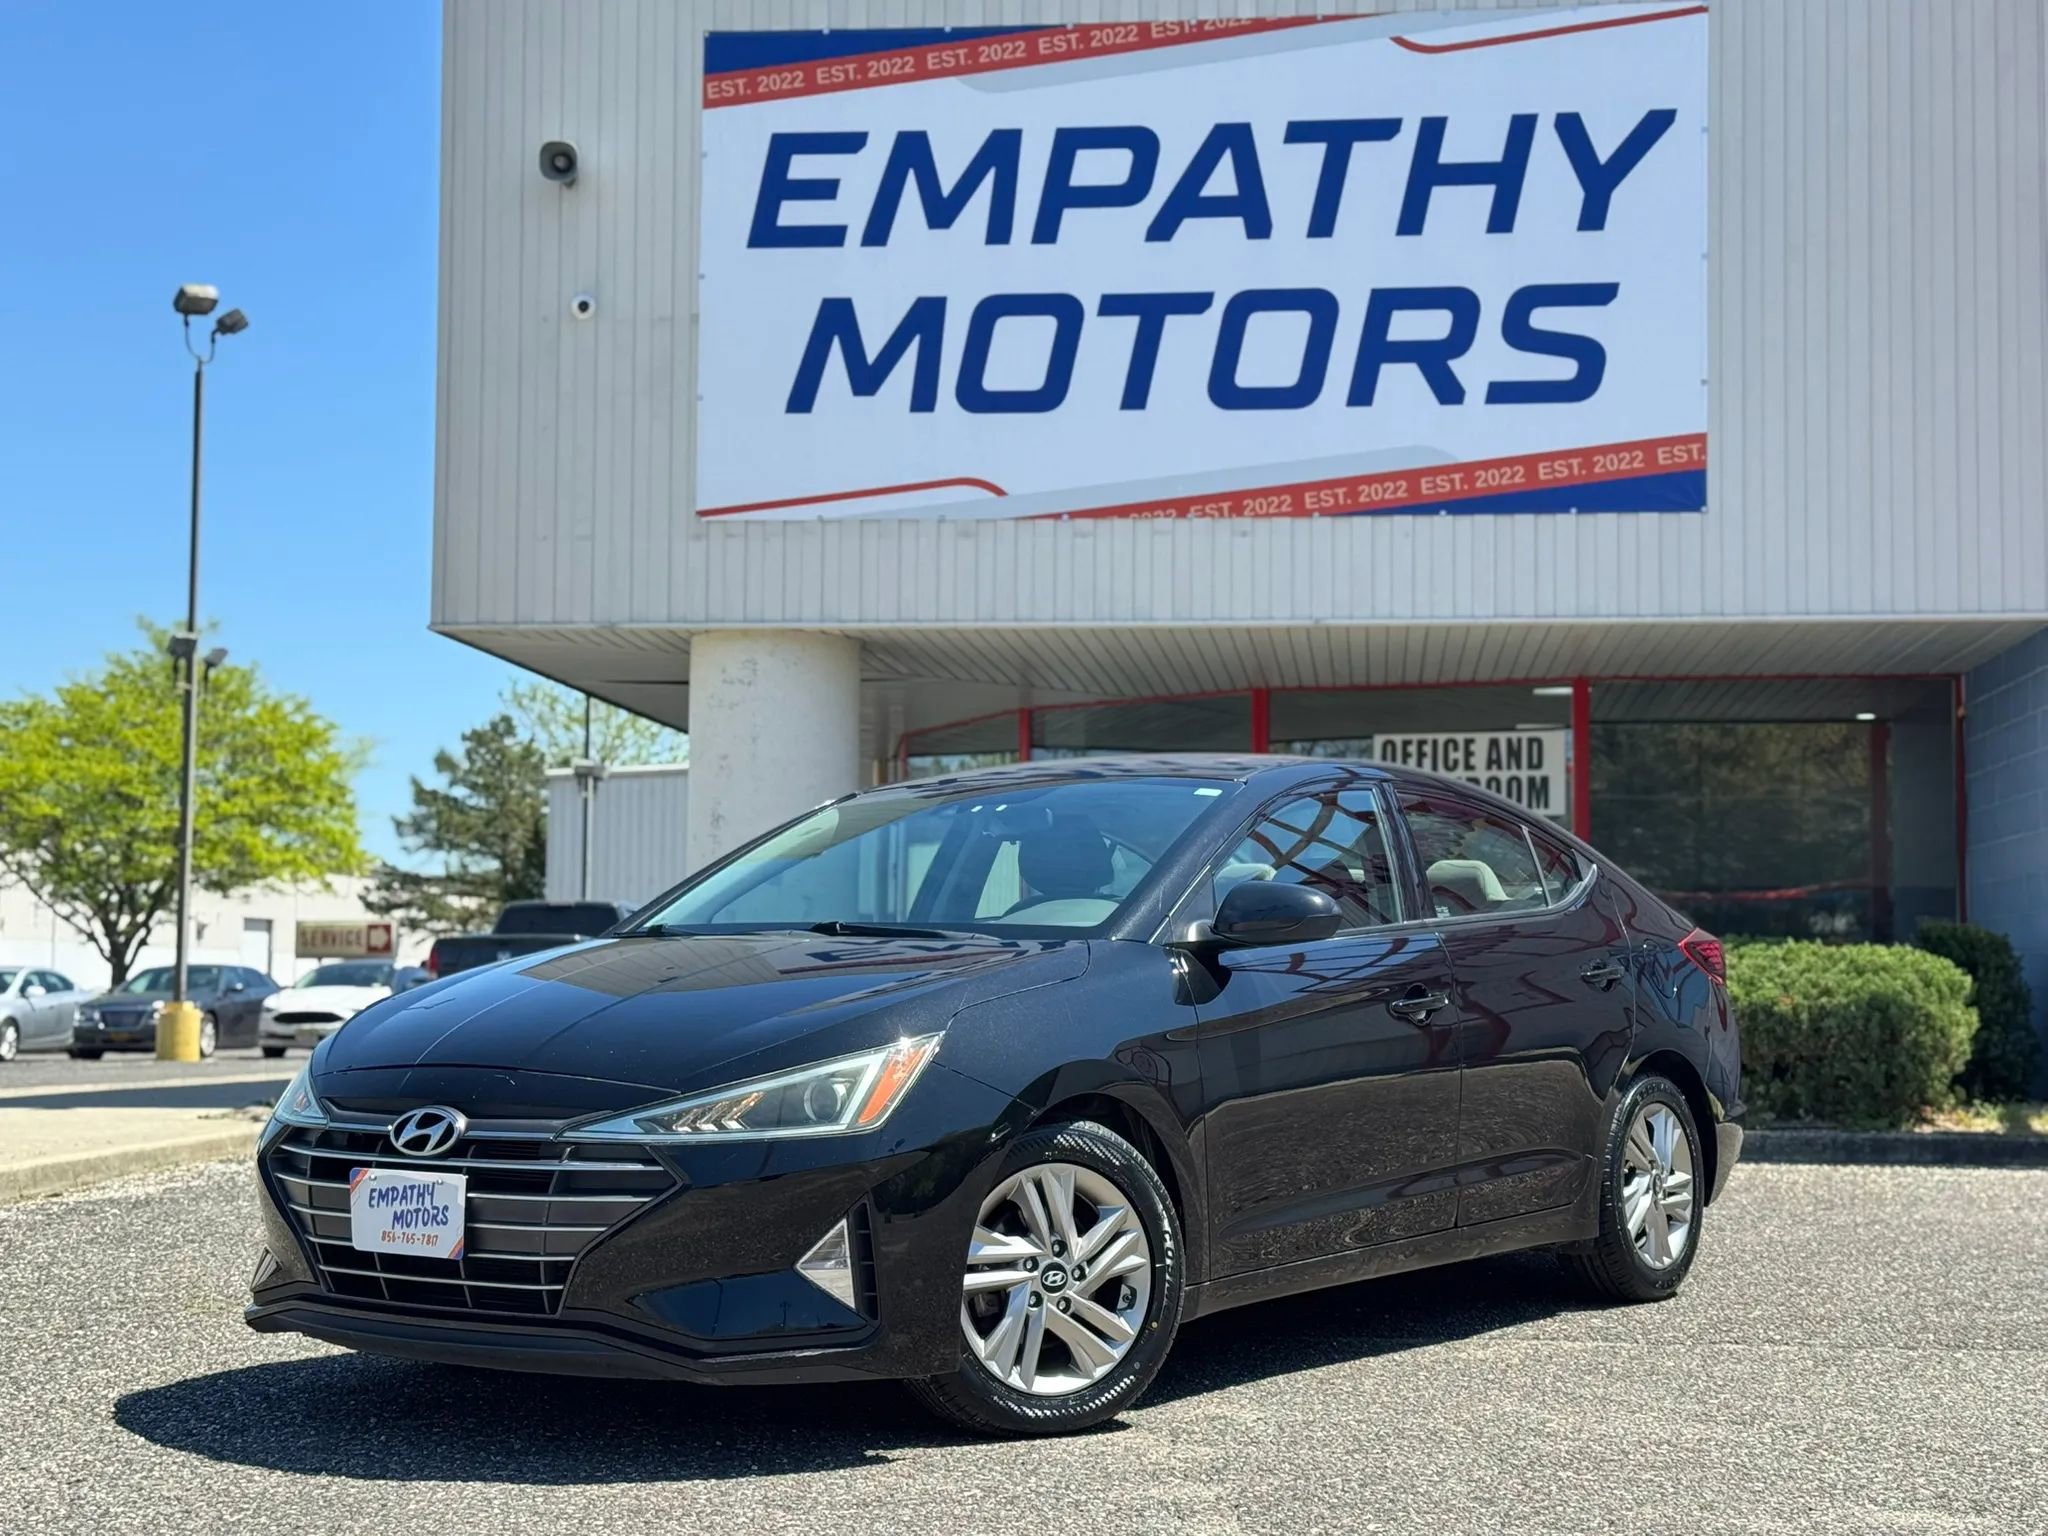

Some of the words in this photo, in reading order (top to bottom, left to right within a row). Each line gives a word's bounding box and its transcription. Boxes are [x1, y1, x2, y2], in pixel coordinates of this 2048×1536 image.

[706, 77, 752, 99] EST.
[757, 71, 805, 93] 2022
[815, 63, 862, 85] EST.
[867, 56, 916, 78] 2022
[926, 49, 972, 70] EST.
[978, 41, 1027, 63] 2022
[1038, 33, 1084, 54] EST.
[1090, 25, 1139, 47] 2022
[746, 108, 1678, 249] EMPATHY
[785, 282, 1620, 414] MOTORS
[1243, 495, 1292, 517] 2022
[1304, 487, 1352, 510] EST.
[1358, 480, 1408, 503] 2022
[1420, 472, 1468, 495] EST.
[1475, 465, 1525, 488] 2022
[1538, 458, 1587, 481] EST.
[1593, 450, 1644, 473] 2022
[1657, 443, 1706, 466] EST.
[1381, 737, 1475, 772] OFFICE
[1486, 736, 1544, 771] AND
[300, 929, 363, 948] SERVICE
[368, 1182, 436, 1208] EMPATHY
[392, 1204, 449, 1230] MOTORS
